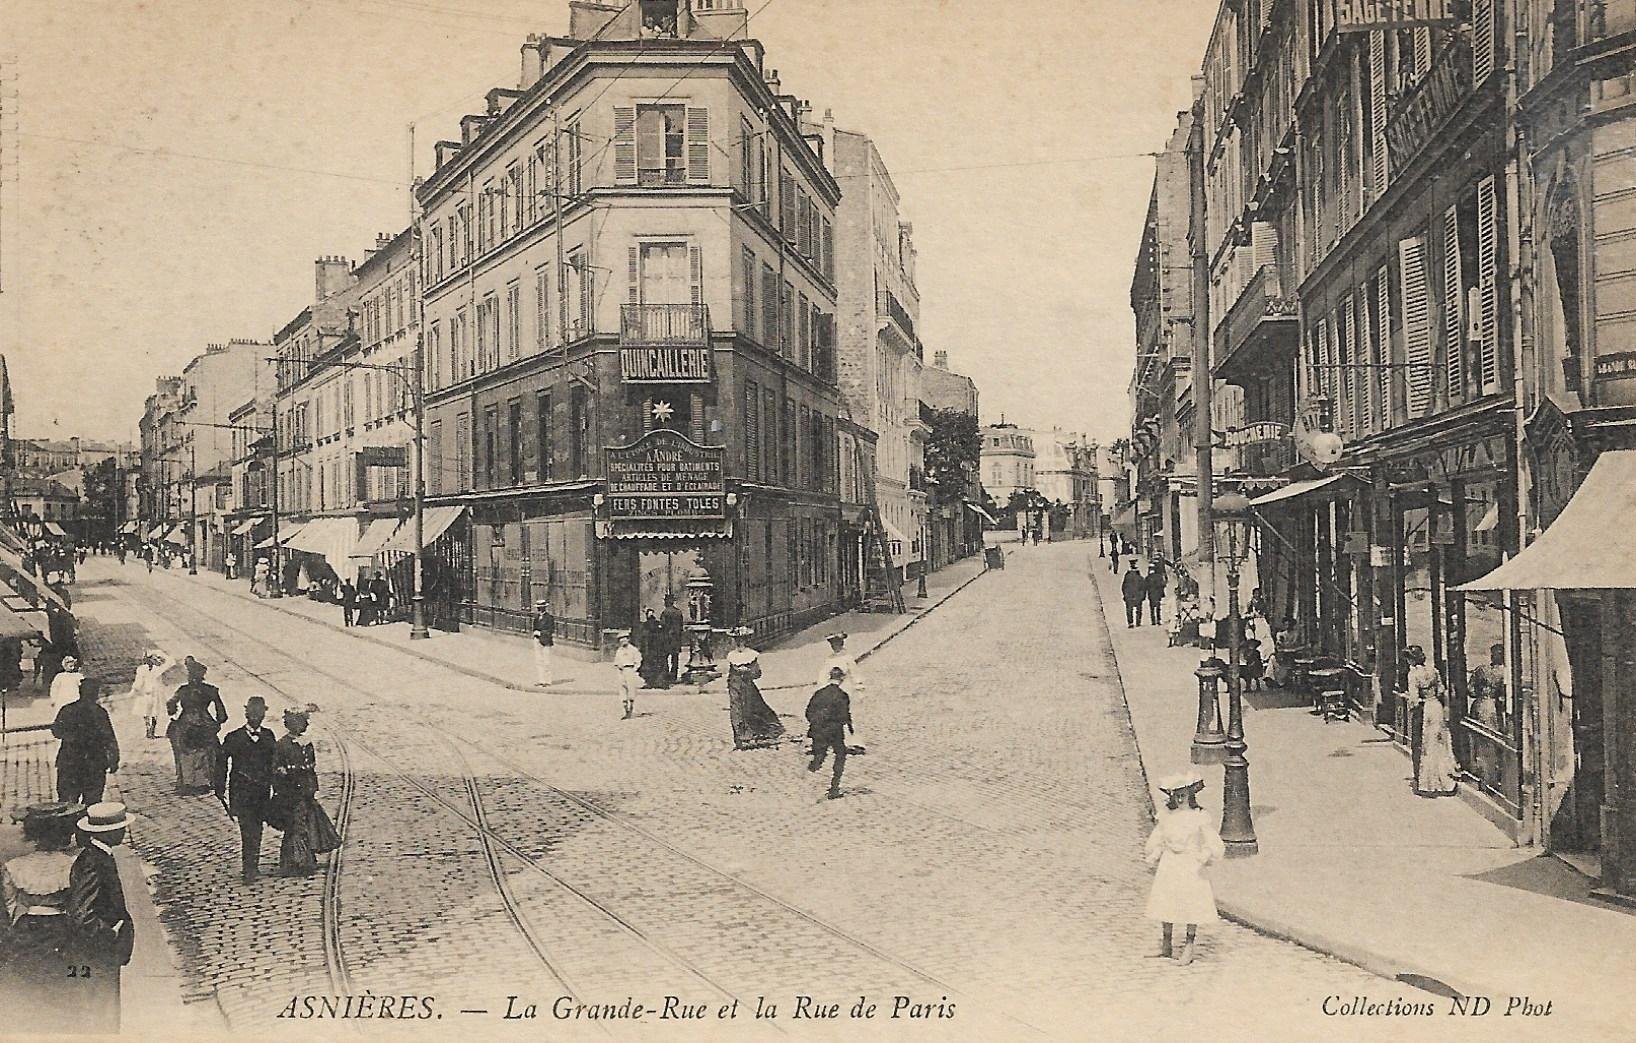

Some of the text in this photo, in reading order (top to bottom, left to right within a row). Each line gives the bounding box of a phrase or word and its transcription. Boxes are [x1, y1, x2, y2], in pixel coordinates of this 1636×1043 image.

[621, 349, 709, 379] QUINCAILLERIE
[1224, 424, 1282, 446] BOUCHERIE
[657, 463, 676, 472] POUR
[661, 473, 671, 481] DE
[662, 482, 672, 491] ET
[613, 498, 637, 510] FERS
[641, 498, 679, 510] FONTES
